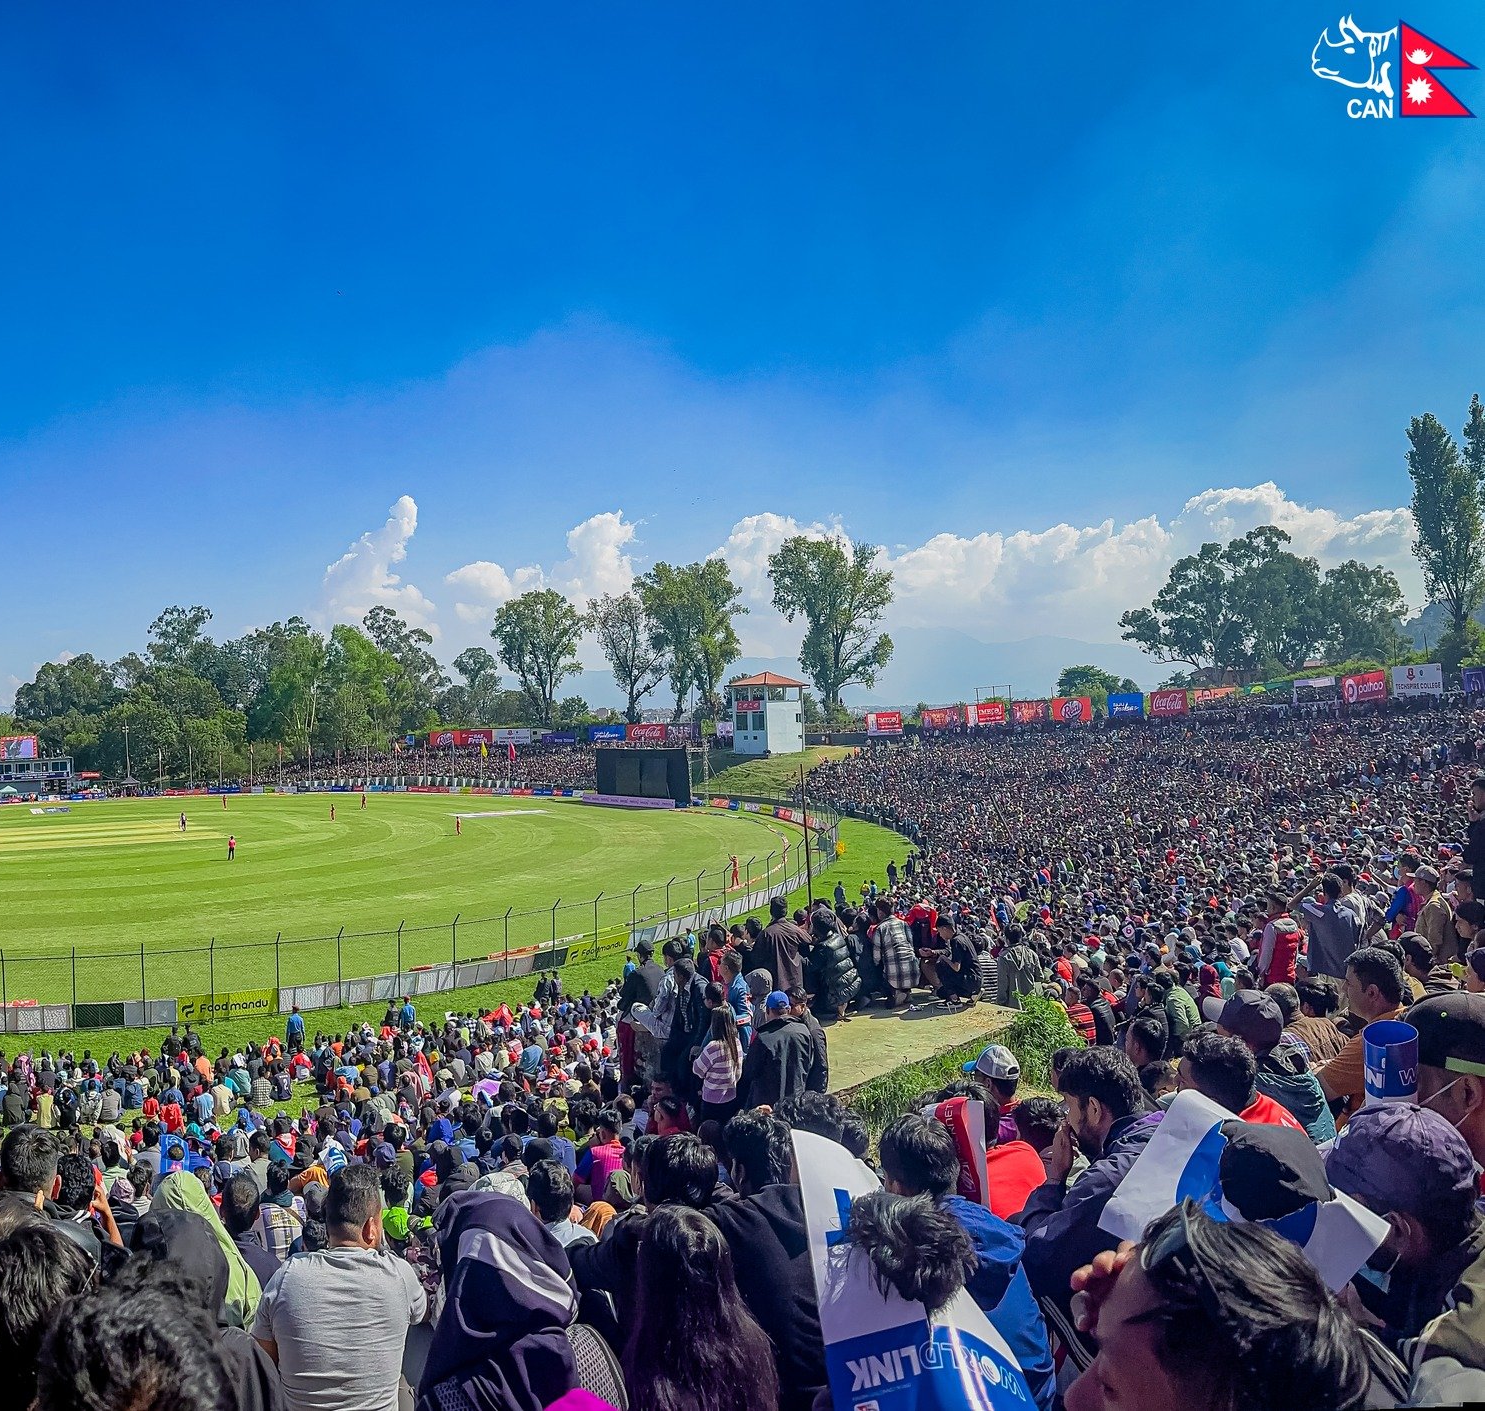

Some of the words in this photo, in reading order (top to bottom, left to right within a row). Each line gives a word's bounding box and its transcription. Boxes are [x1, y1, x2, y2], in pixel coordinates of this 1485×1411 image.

[1358, 680, 1384, 695] pathao
[200, 998, 269, 1013] Foodmandu
[845, 1341, 1026, 1402] WORLDLINK
